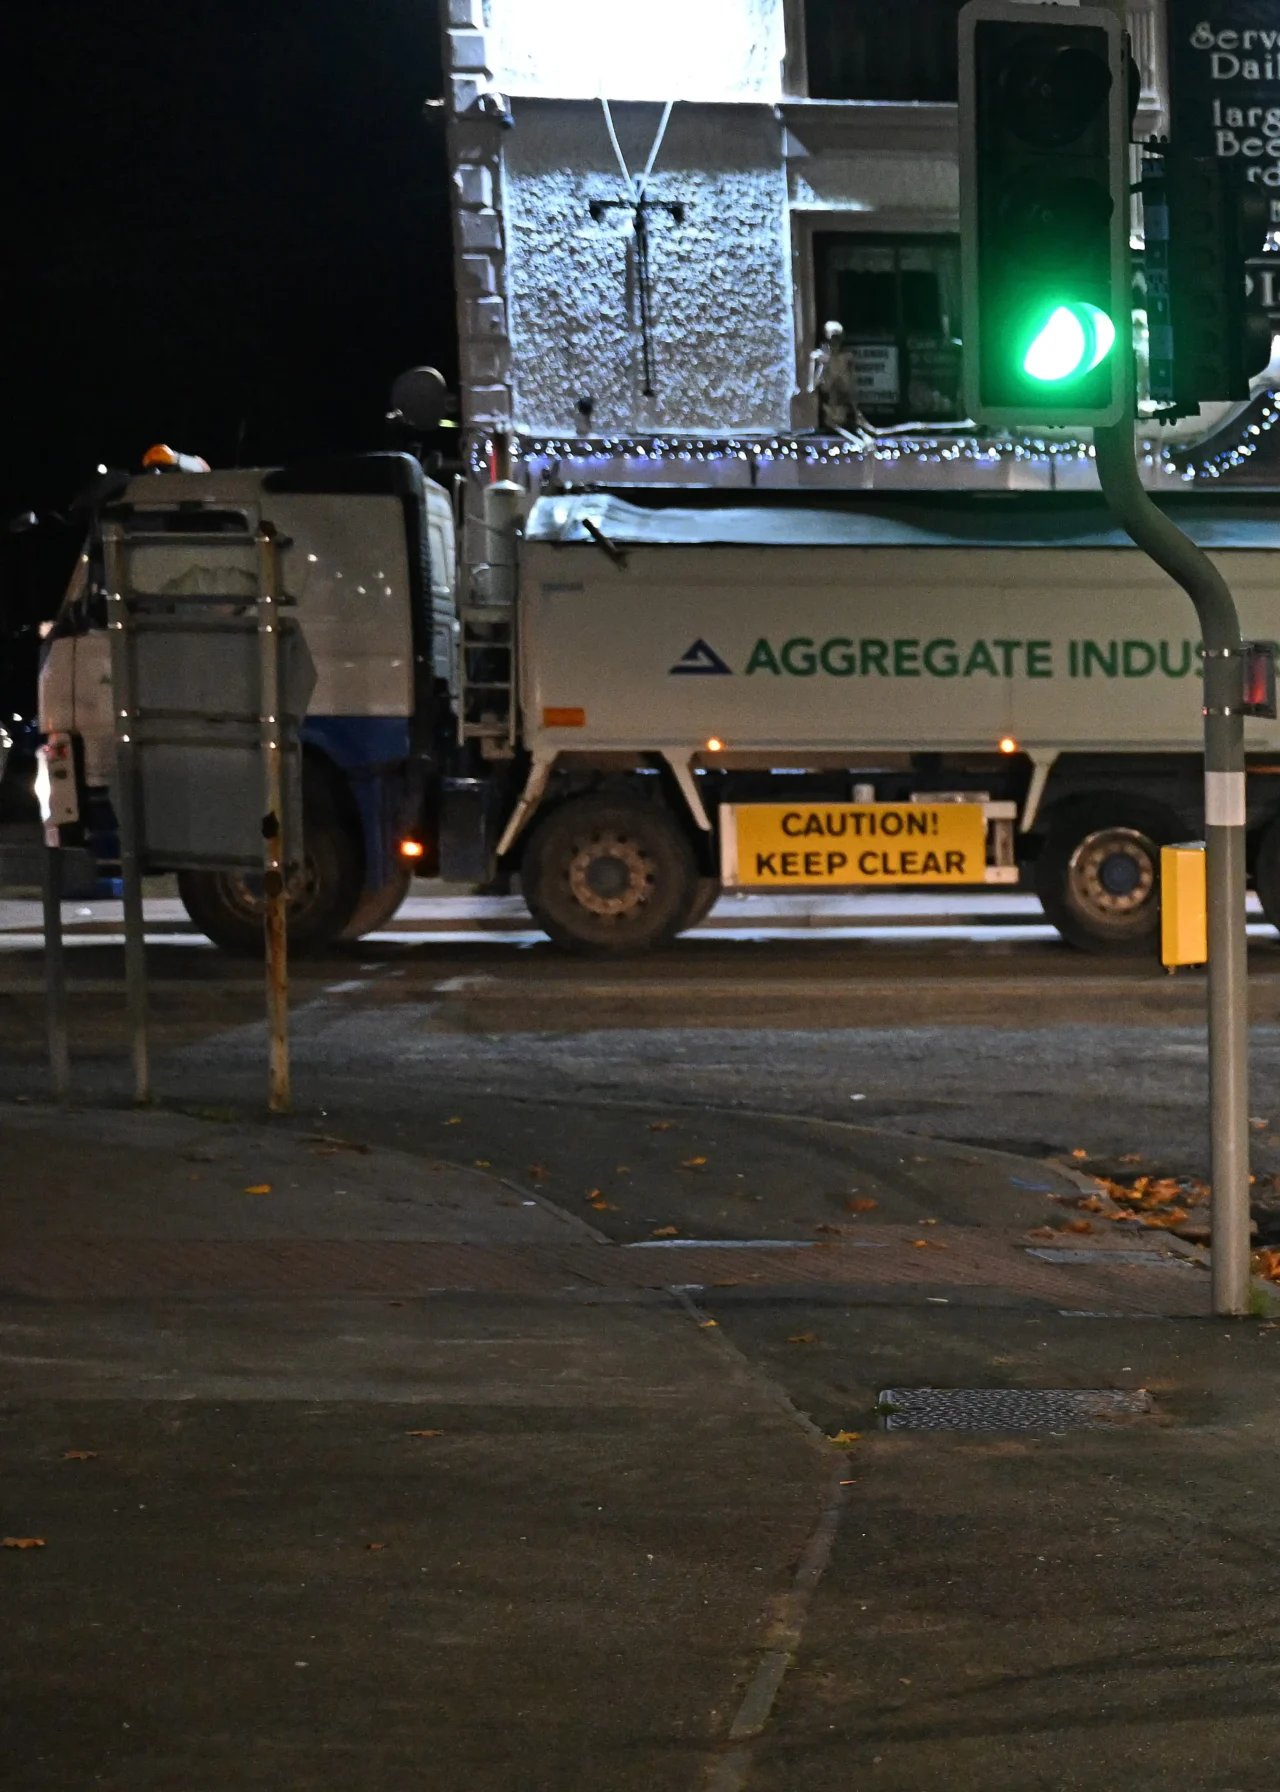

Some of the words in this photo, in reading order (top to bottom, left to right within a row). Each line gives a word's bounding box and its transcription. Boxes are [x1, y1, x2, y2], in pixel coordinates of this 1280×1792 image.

[745, 637, 1053, 679] AGGREGATE
[781, 812, 939, 837] CAUTION!
[756, 851, 848, 877] KEEP
[858, 850, 966, 876] CLEAR
